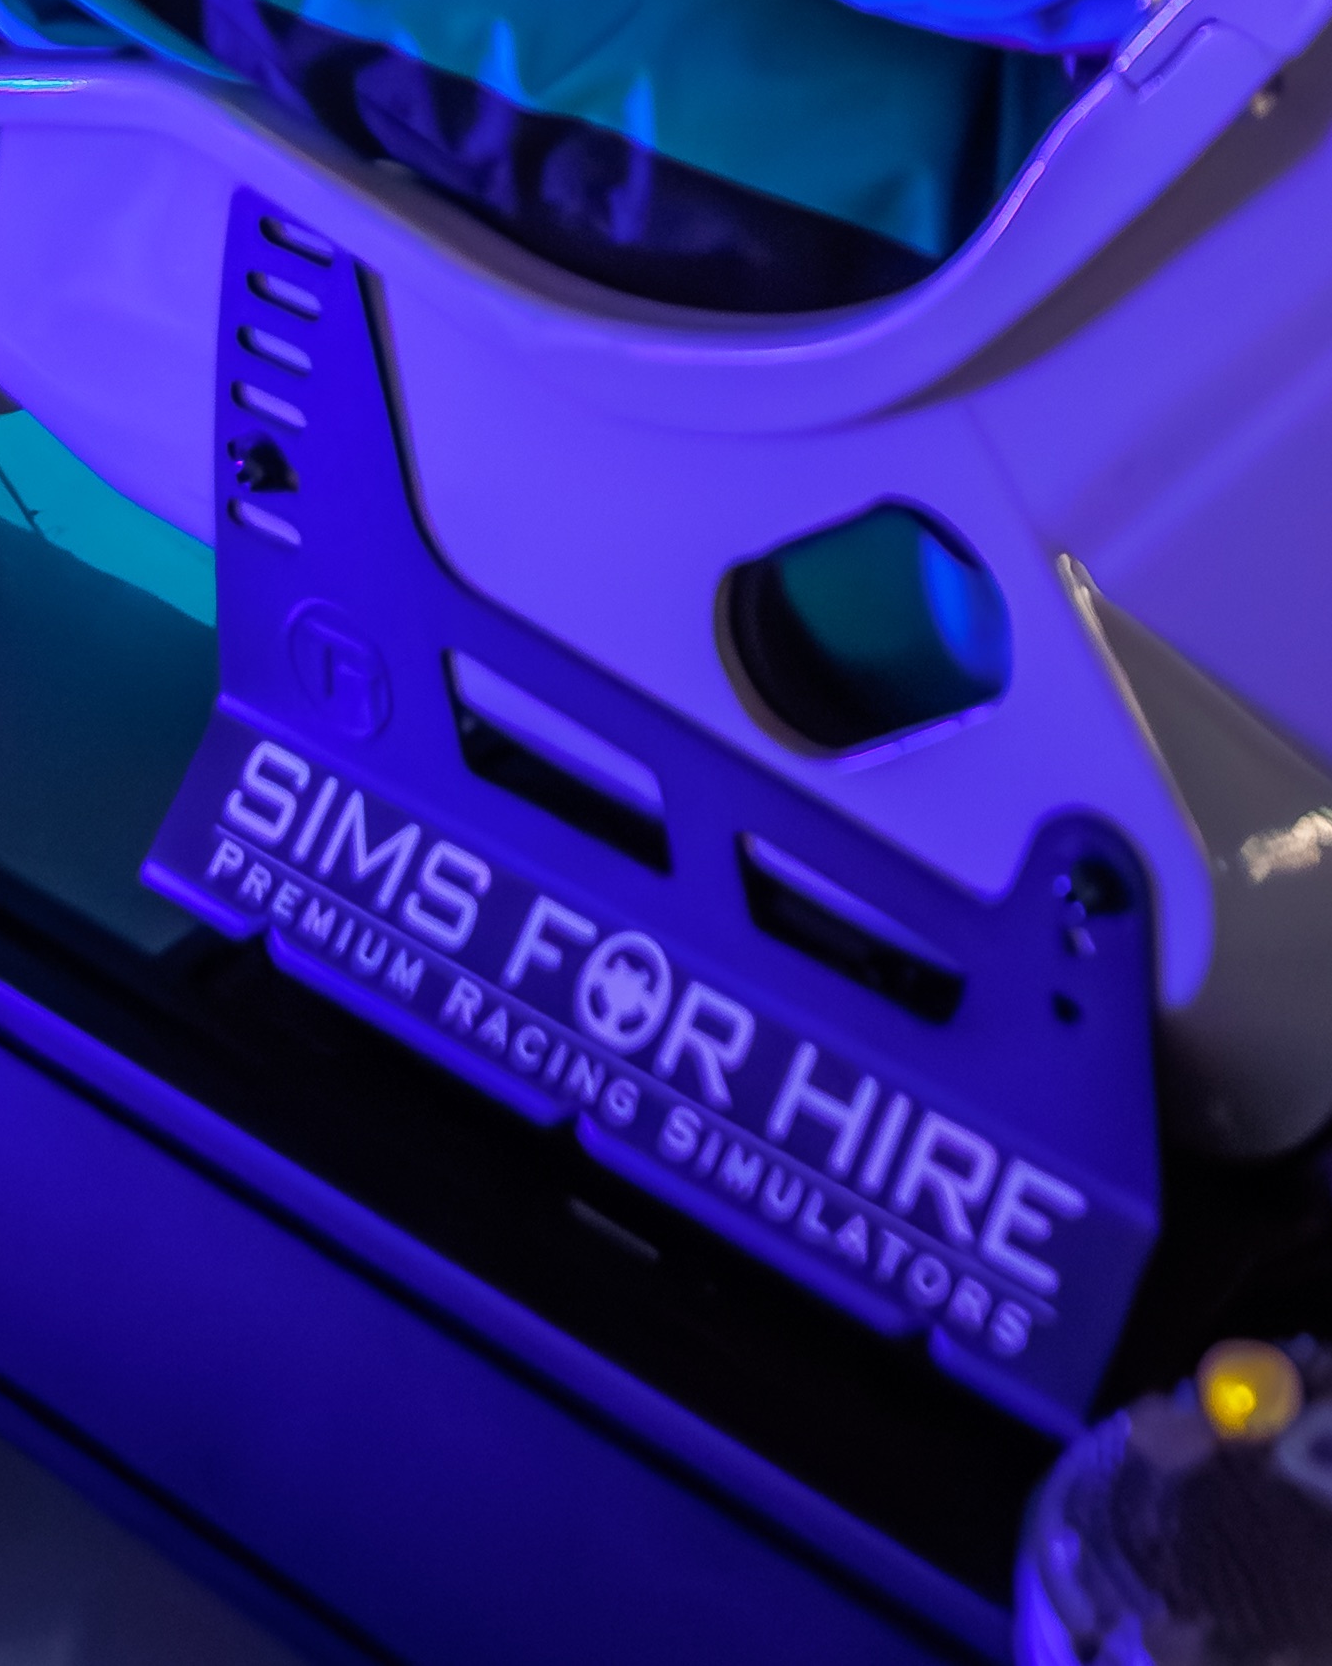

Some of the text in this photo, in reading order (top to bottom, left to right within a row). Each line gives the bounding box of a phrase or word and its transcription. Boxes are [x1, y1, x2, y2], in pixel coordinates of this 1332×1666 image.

[208, 837, 1034, 1358] PREMIUM RACING SIMULATORS
[225, 739, 1089, 1297] SIMS FOR HIRE
